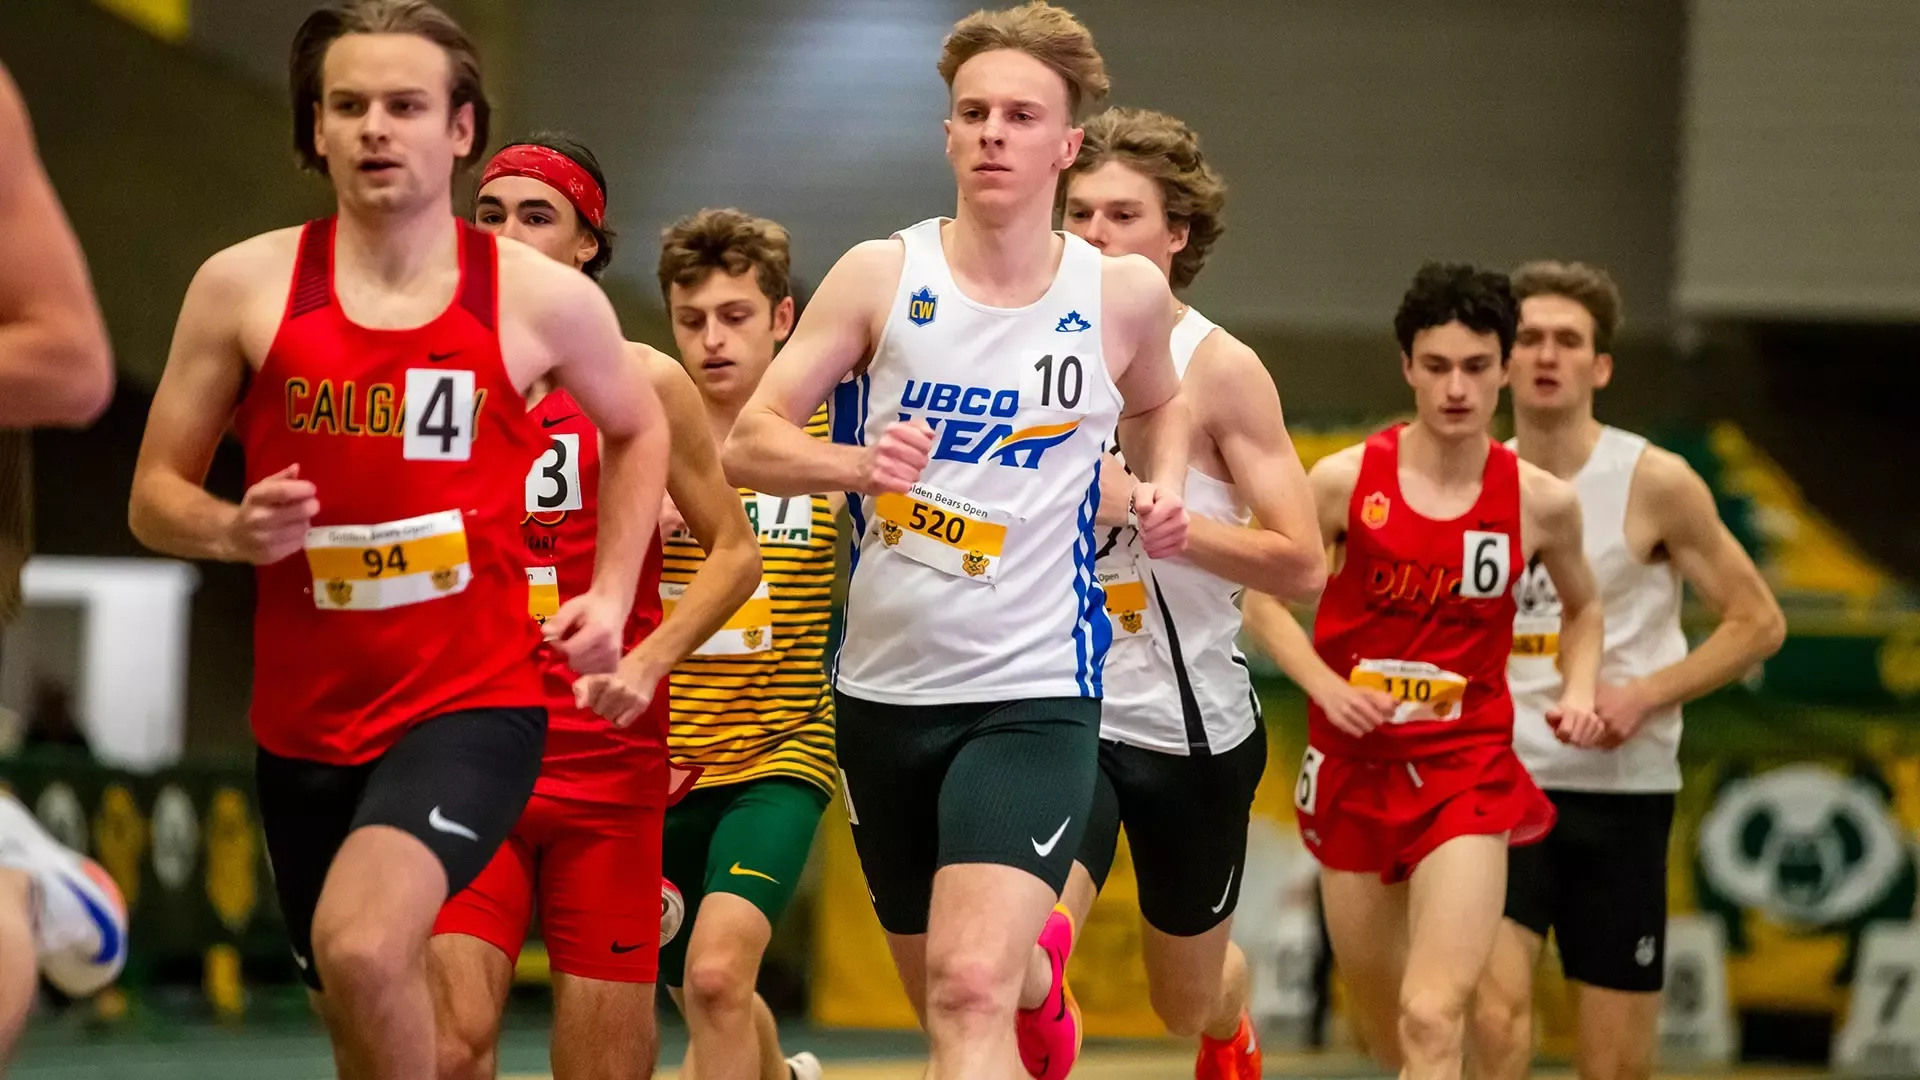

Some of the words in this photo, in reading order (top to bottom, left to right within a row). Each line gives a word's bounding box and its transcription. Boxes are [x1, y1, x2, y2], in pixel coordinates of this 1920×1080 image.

[911, 299, 934, 320] CW
[900, 379, 1019, 418] UBCO
[1034, 354, 1083, 410] 10
[417, 376, 459, 454] 4
[898, 412, 1082, 470] EAT
[537, 439, 569, 508] 3
[909, 484, 933, 500] lden
[935, 493, 961, 509] Bears
[963, 502, 988, 519] Open
[909, 502, 966, 544] 520
[362, 544, 409, 578] 94
[1099, 573, 1120, 583] Open
[1473, 538, 1499, 594] 6
[1384, 678, 1431, 702] 110
